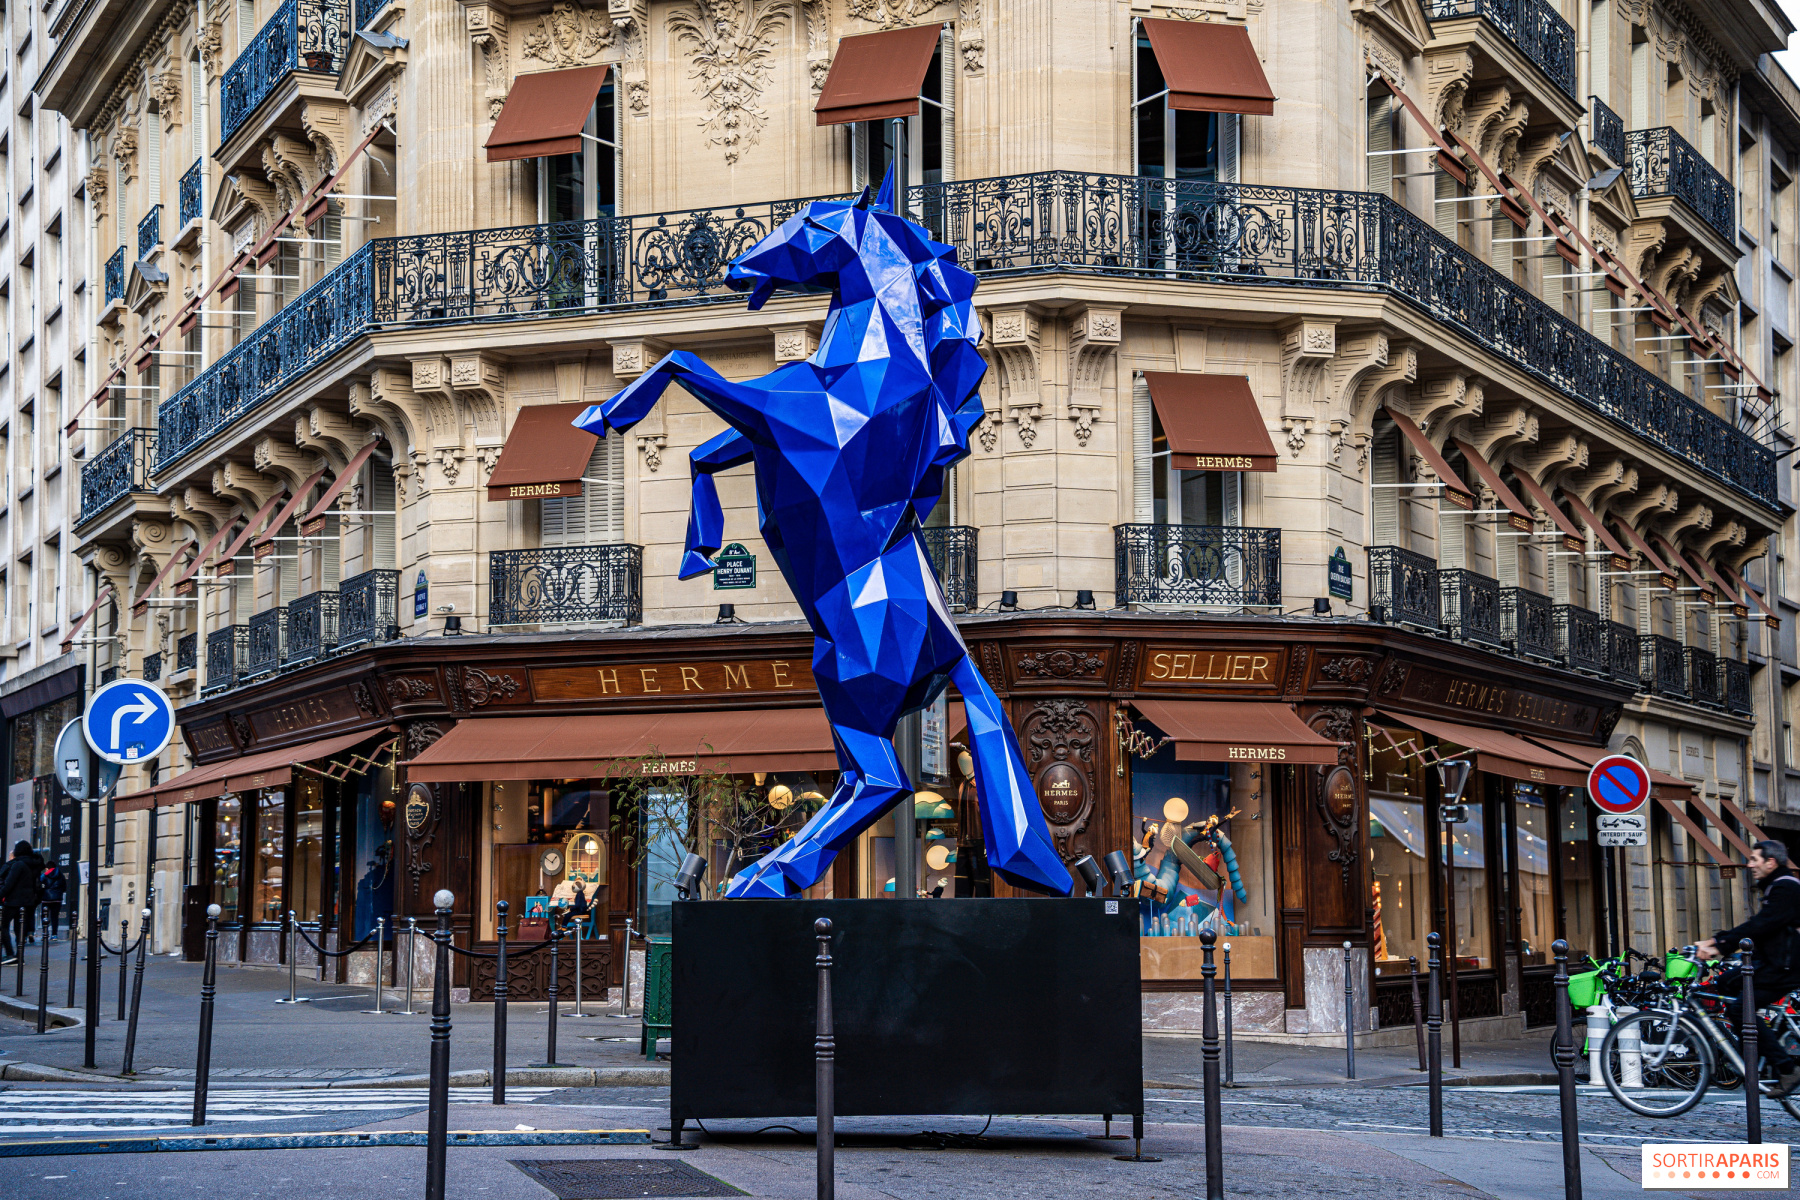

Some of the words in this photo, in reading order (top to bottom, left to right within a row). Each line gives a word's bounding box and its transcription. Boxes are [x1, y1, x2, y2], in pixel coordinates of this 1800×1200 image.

[1196, 456, 1252, 468] HERMÈS
[510, 483, 560, 497] HERMÈS
[1151, 653, 1268, 680] SELLIER
[1515, 694, 1568, 725] SELLIER
[1229, 747, 1286, 760] HERMÈS
